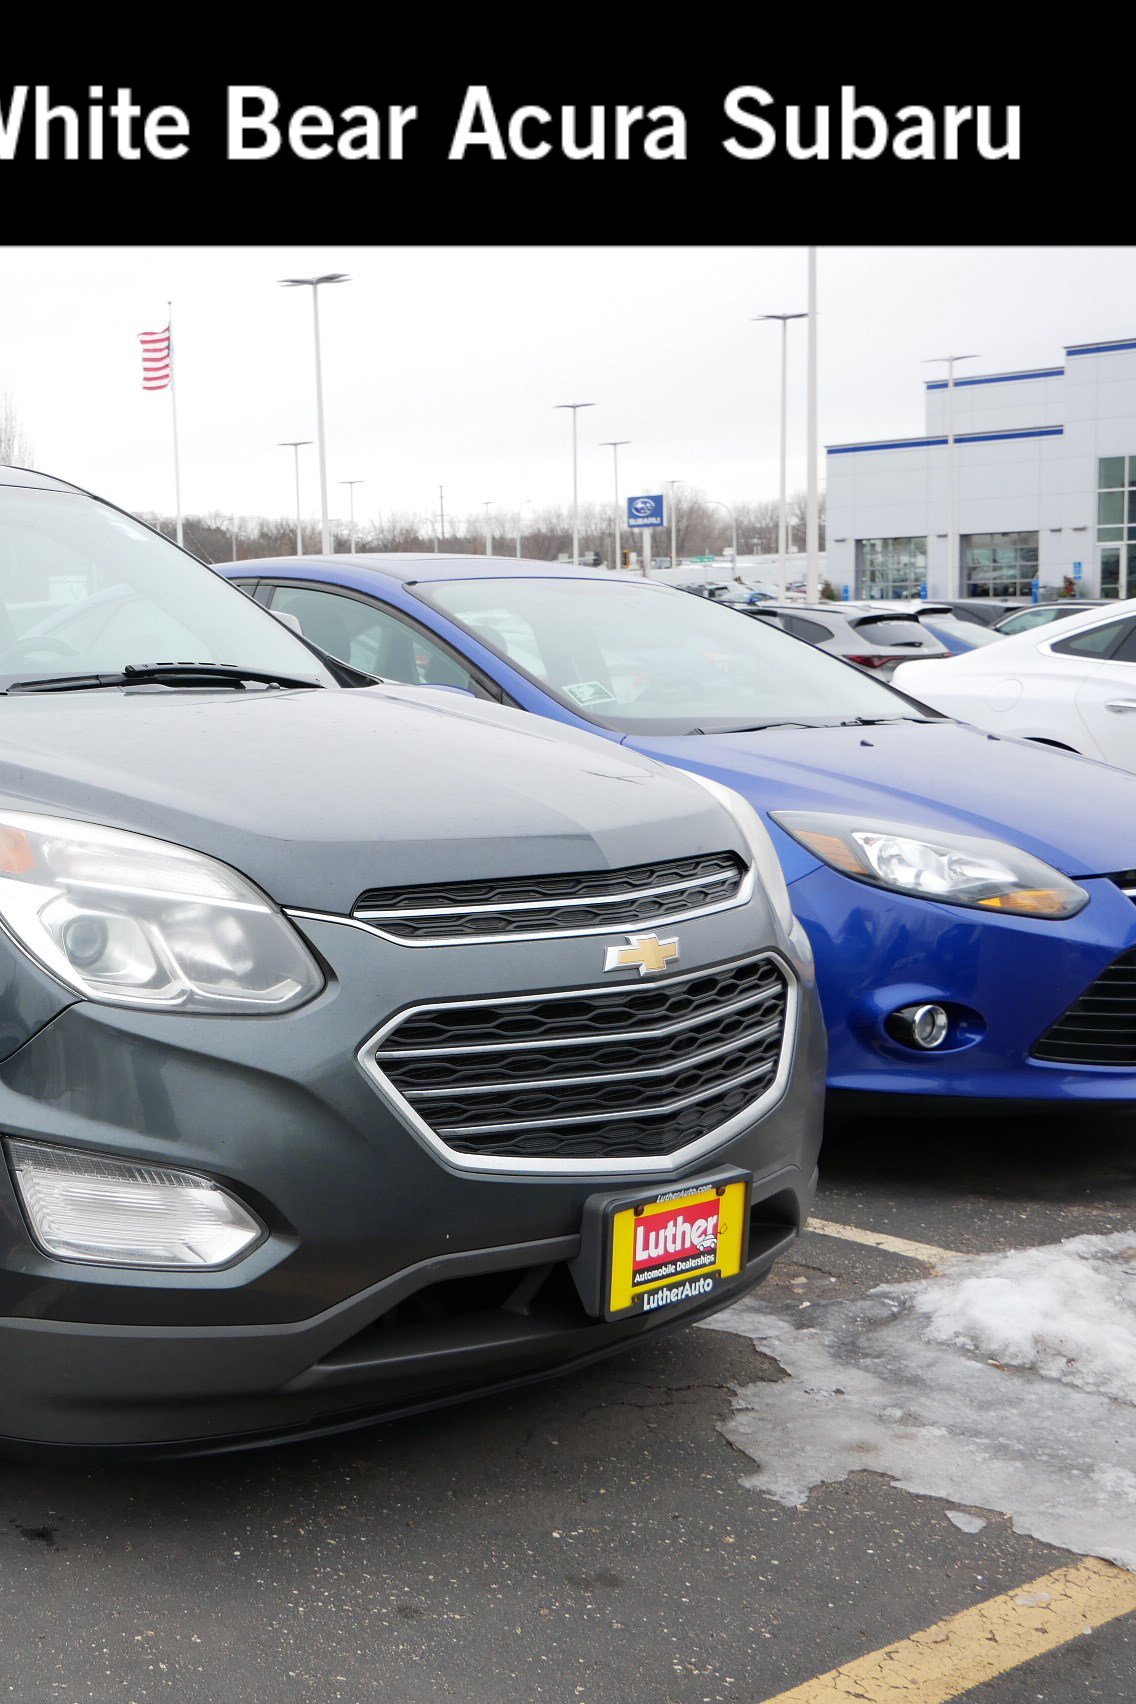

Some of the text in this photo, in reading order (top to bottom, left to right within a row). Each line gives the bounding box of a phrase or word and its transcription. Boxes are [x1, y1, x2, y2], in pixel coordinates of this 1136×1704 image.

[628, 517, 661, 525] SUBARU
[656, 1185, 713, 1203] LutherAuto.com
[635, 1215, 717, 1261] Luther
[635, 1253, 715, 1282] Automobile Dealerships
[643, 1278, 713, 1310] LutherAuto
